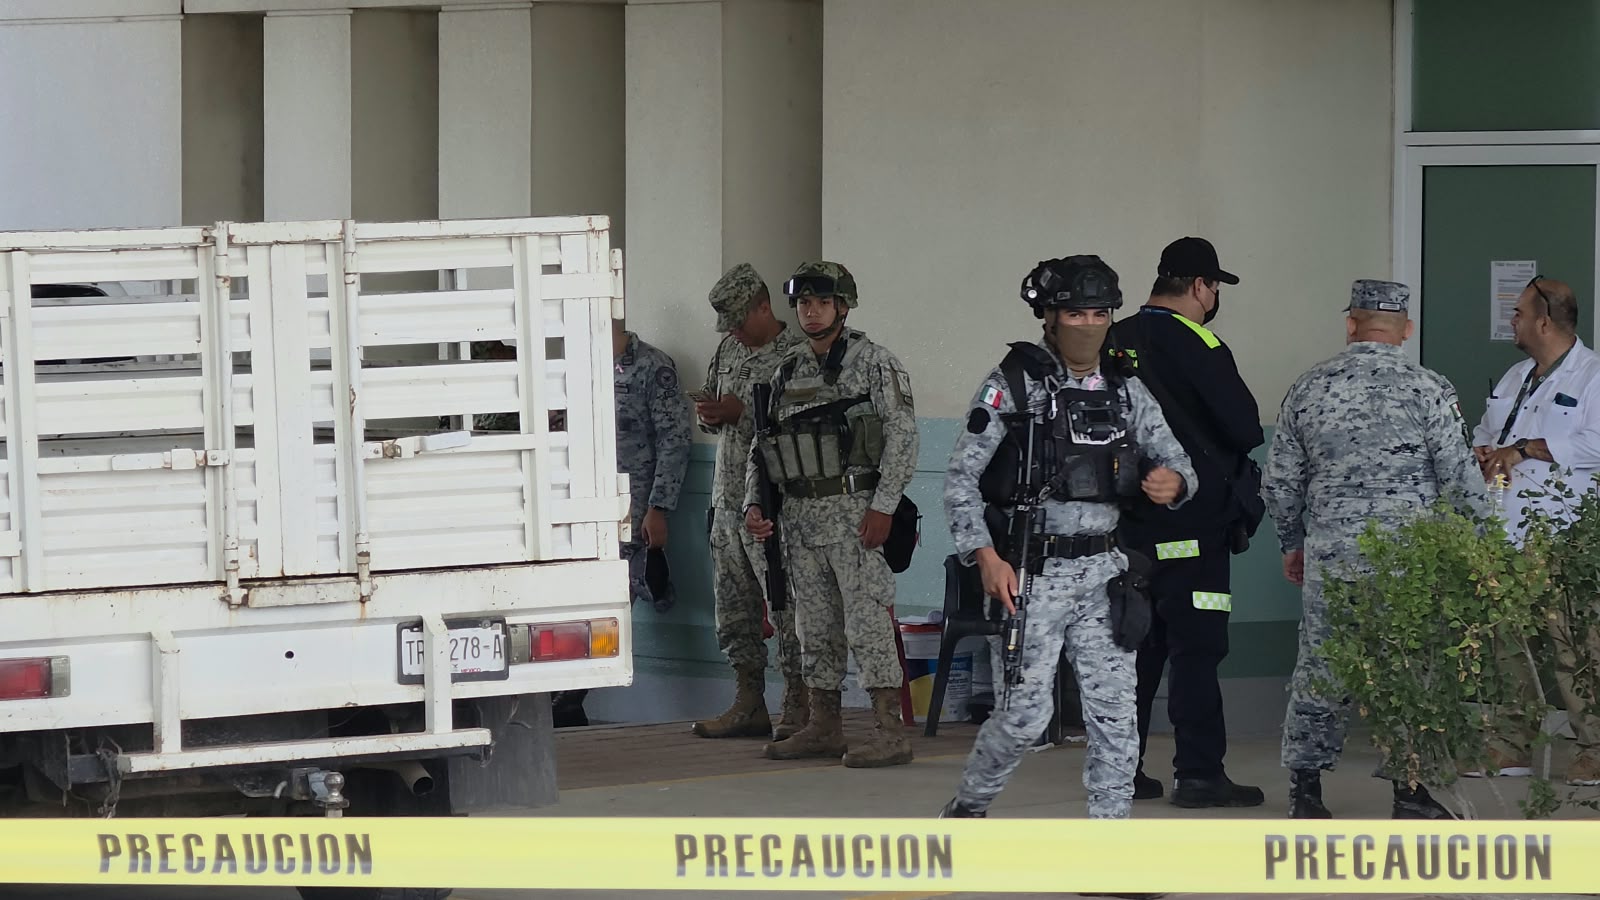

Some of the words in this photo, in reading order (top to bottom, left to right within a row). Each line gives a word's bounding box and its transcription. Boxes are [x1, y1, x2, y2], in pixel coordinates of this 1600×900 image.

[96, 833, 373, 875] PRECAUCION
[674, 833, 953, 878] PRECAUCION
[1264, 834, 1552, 880] PRECAUCION
